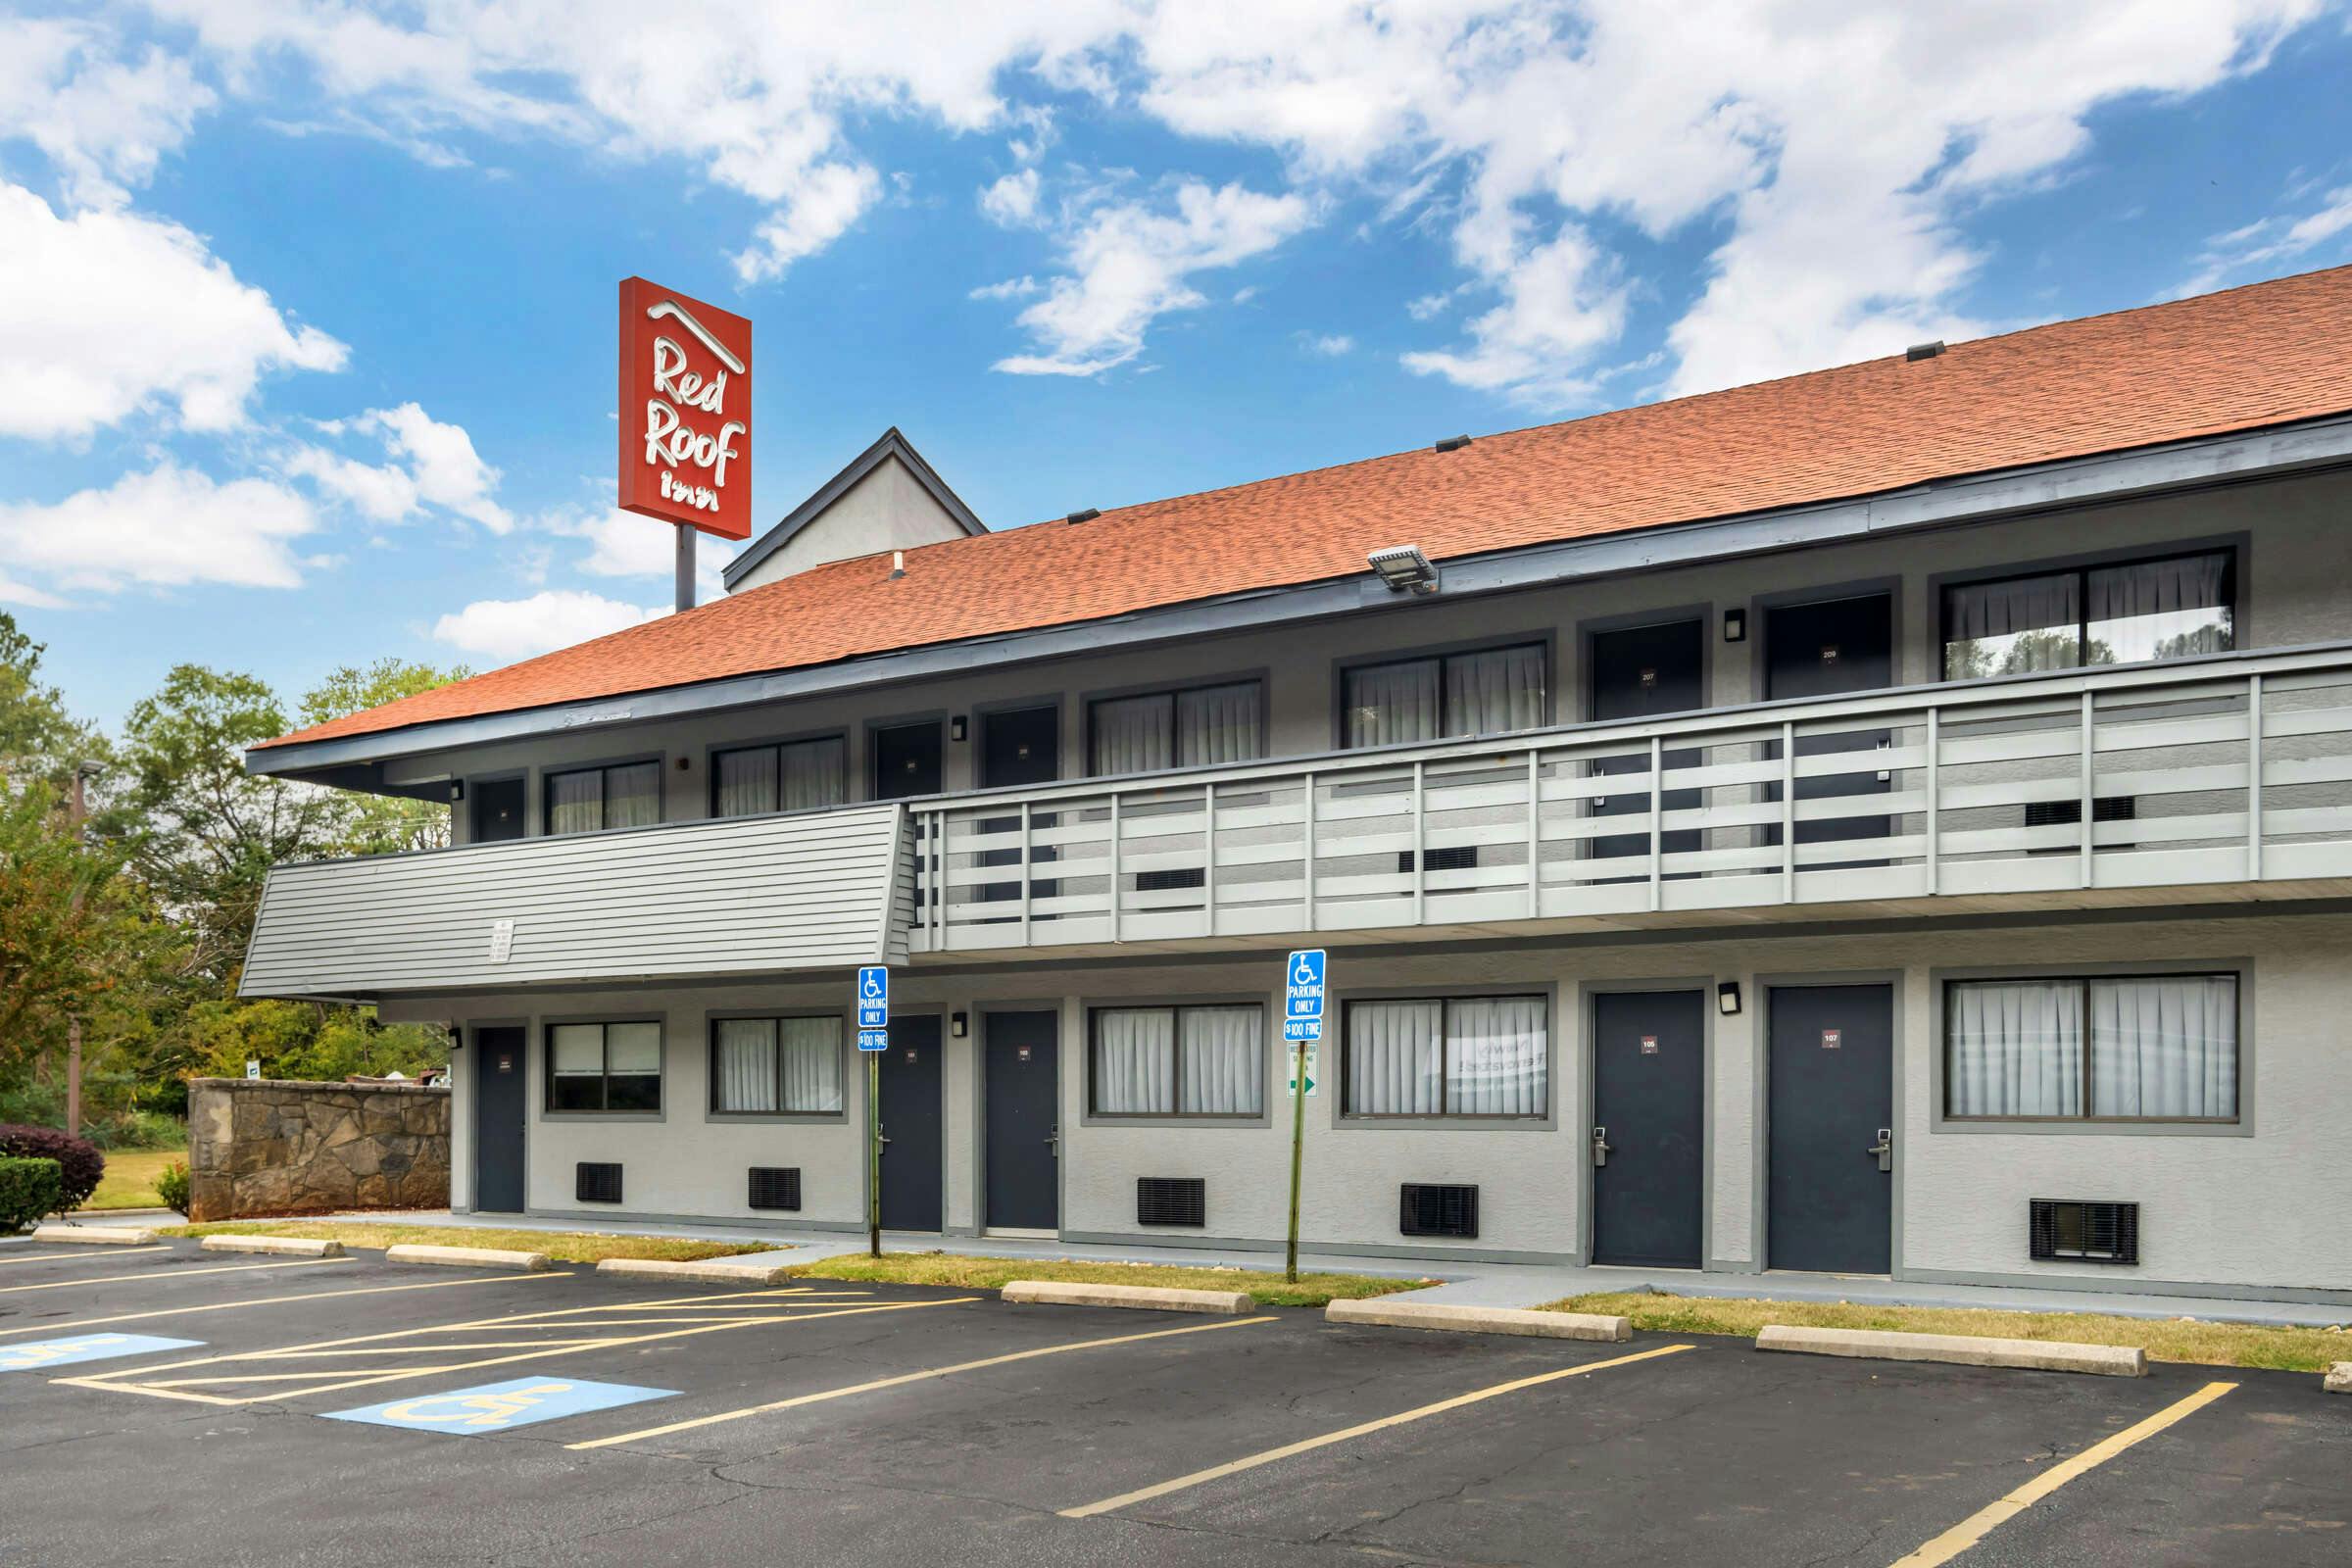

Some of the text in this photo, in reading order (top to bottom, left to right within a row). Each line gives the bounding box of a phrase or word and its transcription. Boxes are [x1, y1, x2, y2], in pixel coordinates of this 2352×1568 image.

[654, 336, 727, 415] Red
[644, 399, 746, 487] Roof
[661, 469, 719, 513] Inn
[1289, 984, 1322, 998] PARKING
[860, 998, 886, 1009] PARKING
[1295, 1000, 1314, 1013] ONLY
[865, 1010, 881, 1023] ONLY
[1286, 1022, 1320, 1036] $100 FINE
[874, 1034, 886, 1046] FINE
